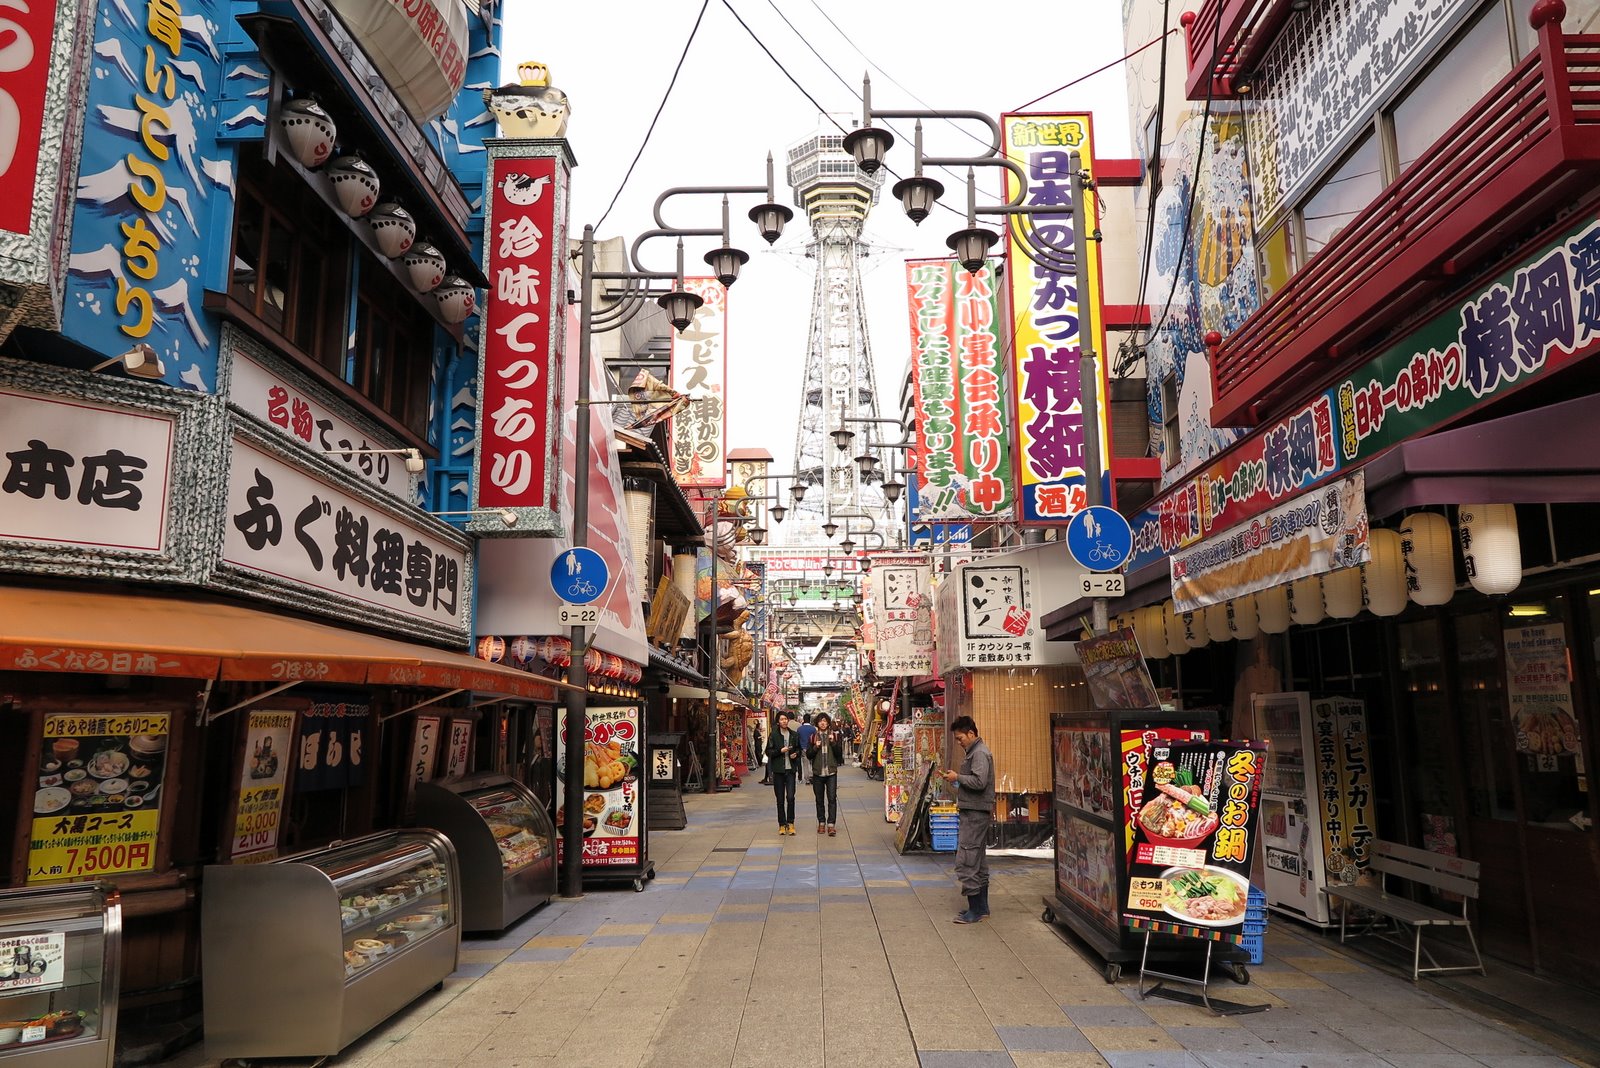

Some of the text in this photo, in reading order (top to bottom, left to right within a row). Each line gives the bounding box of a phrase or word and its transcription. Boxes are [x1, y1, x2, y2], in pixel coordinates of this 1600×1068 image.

[1011, 122, 1083, 146] 新世界
[491, 215, 543, 495] 珍味てっちり
[1461, 249, 1574, 397] 横綱
[829, 268, 854, 512] 安心と信頼の日立ループ
[1023, 347, 1092, 480] 横綱
[1340, 383, 1358, 457] 新世界
[1355, 344, 1461, 438] 日本一の串かつ
[695, 396, 722, 462] 串かつ
[1265, 408, 1317, 499] 横綱
[1314, 396, 1334, 474] 酒処
[3, 439, 148, 511] 本店
[1211, 461, 1264, 518] 日本一の串かつ
[234, 468, 458, 616] ふぐ料理専門
[1160, 488, 1190, 553] 横綱
[561, 611, 596, 622] 9-22
[1083, 579, 1122, 592] 9-22
[15, 648, 181, 673] ふぐなら日本一
[271, 661, 329, 678] づぼらや
[978, 642, 1031, 650] カウンター席
[978, 654, 1031, 662] 座敷あります
[52, 813, 134, 835] 大黒コース
[239, 830, 268, 848] 2,100
[245, 812, 276, 831] 3,000
[1212, 750, 1258, 863] 冬のお鍋
[66, 843, 150, 875] 7,500円
